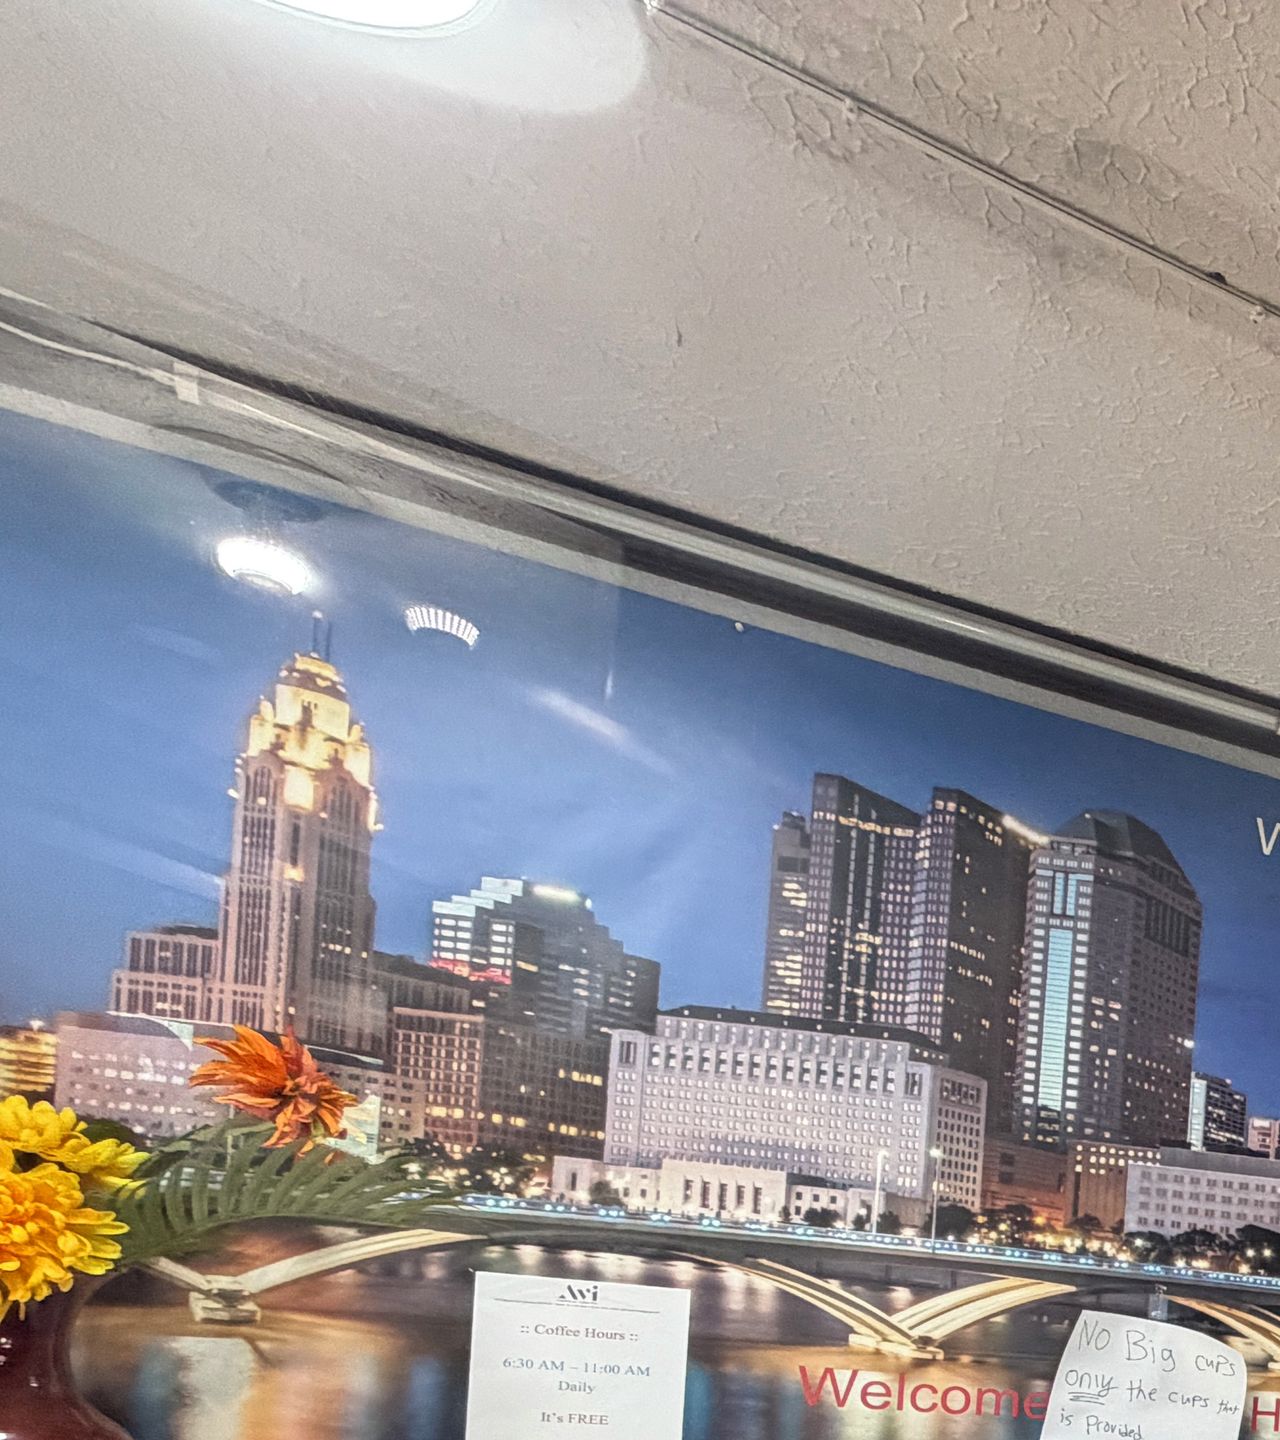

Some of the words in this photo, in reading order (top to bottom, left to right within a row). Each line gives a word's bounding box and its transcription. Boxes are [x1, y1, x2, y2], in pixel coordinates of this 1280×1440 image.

[558, 1284, 598, 1301] Avi
[534, 1323, 581, 1338] Coffee
[585, 1327, 626, 1341] Hours
[1126, 1330, 1176, 1372] Big
[502, 1358, 534, 1369] 6:30
[537, 1360, 565, 1371] AM
[584, 1362, 620, 1375] 11:00
[624, 1366, 651, 1377] AM
[558, 1380, 596, 1395] Daily
[799, 1365, 1050, 1421] Welcome
[1126, 1379, 1158, 1402] the
[568, 1413, 609, 1425] FREE
[1060, 1408, 1073, 1426] is
